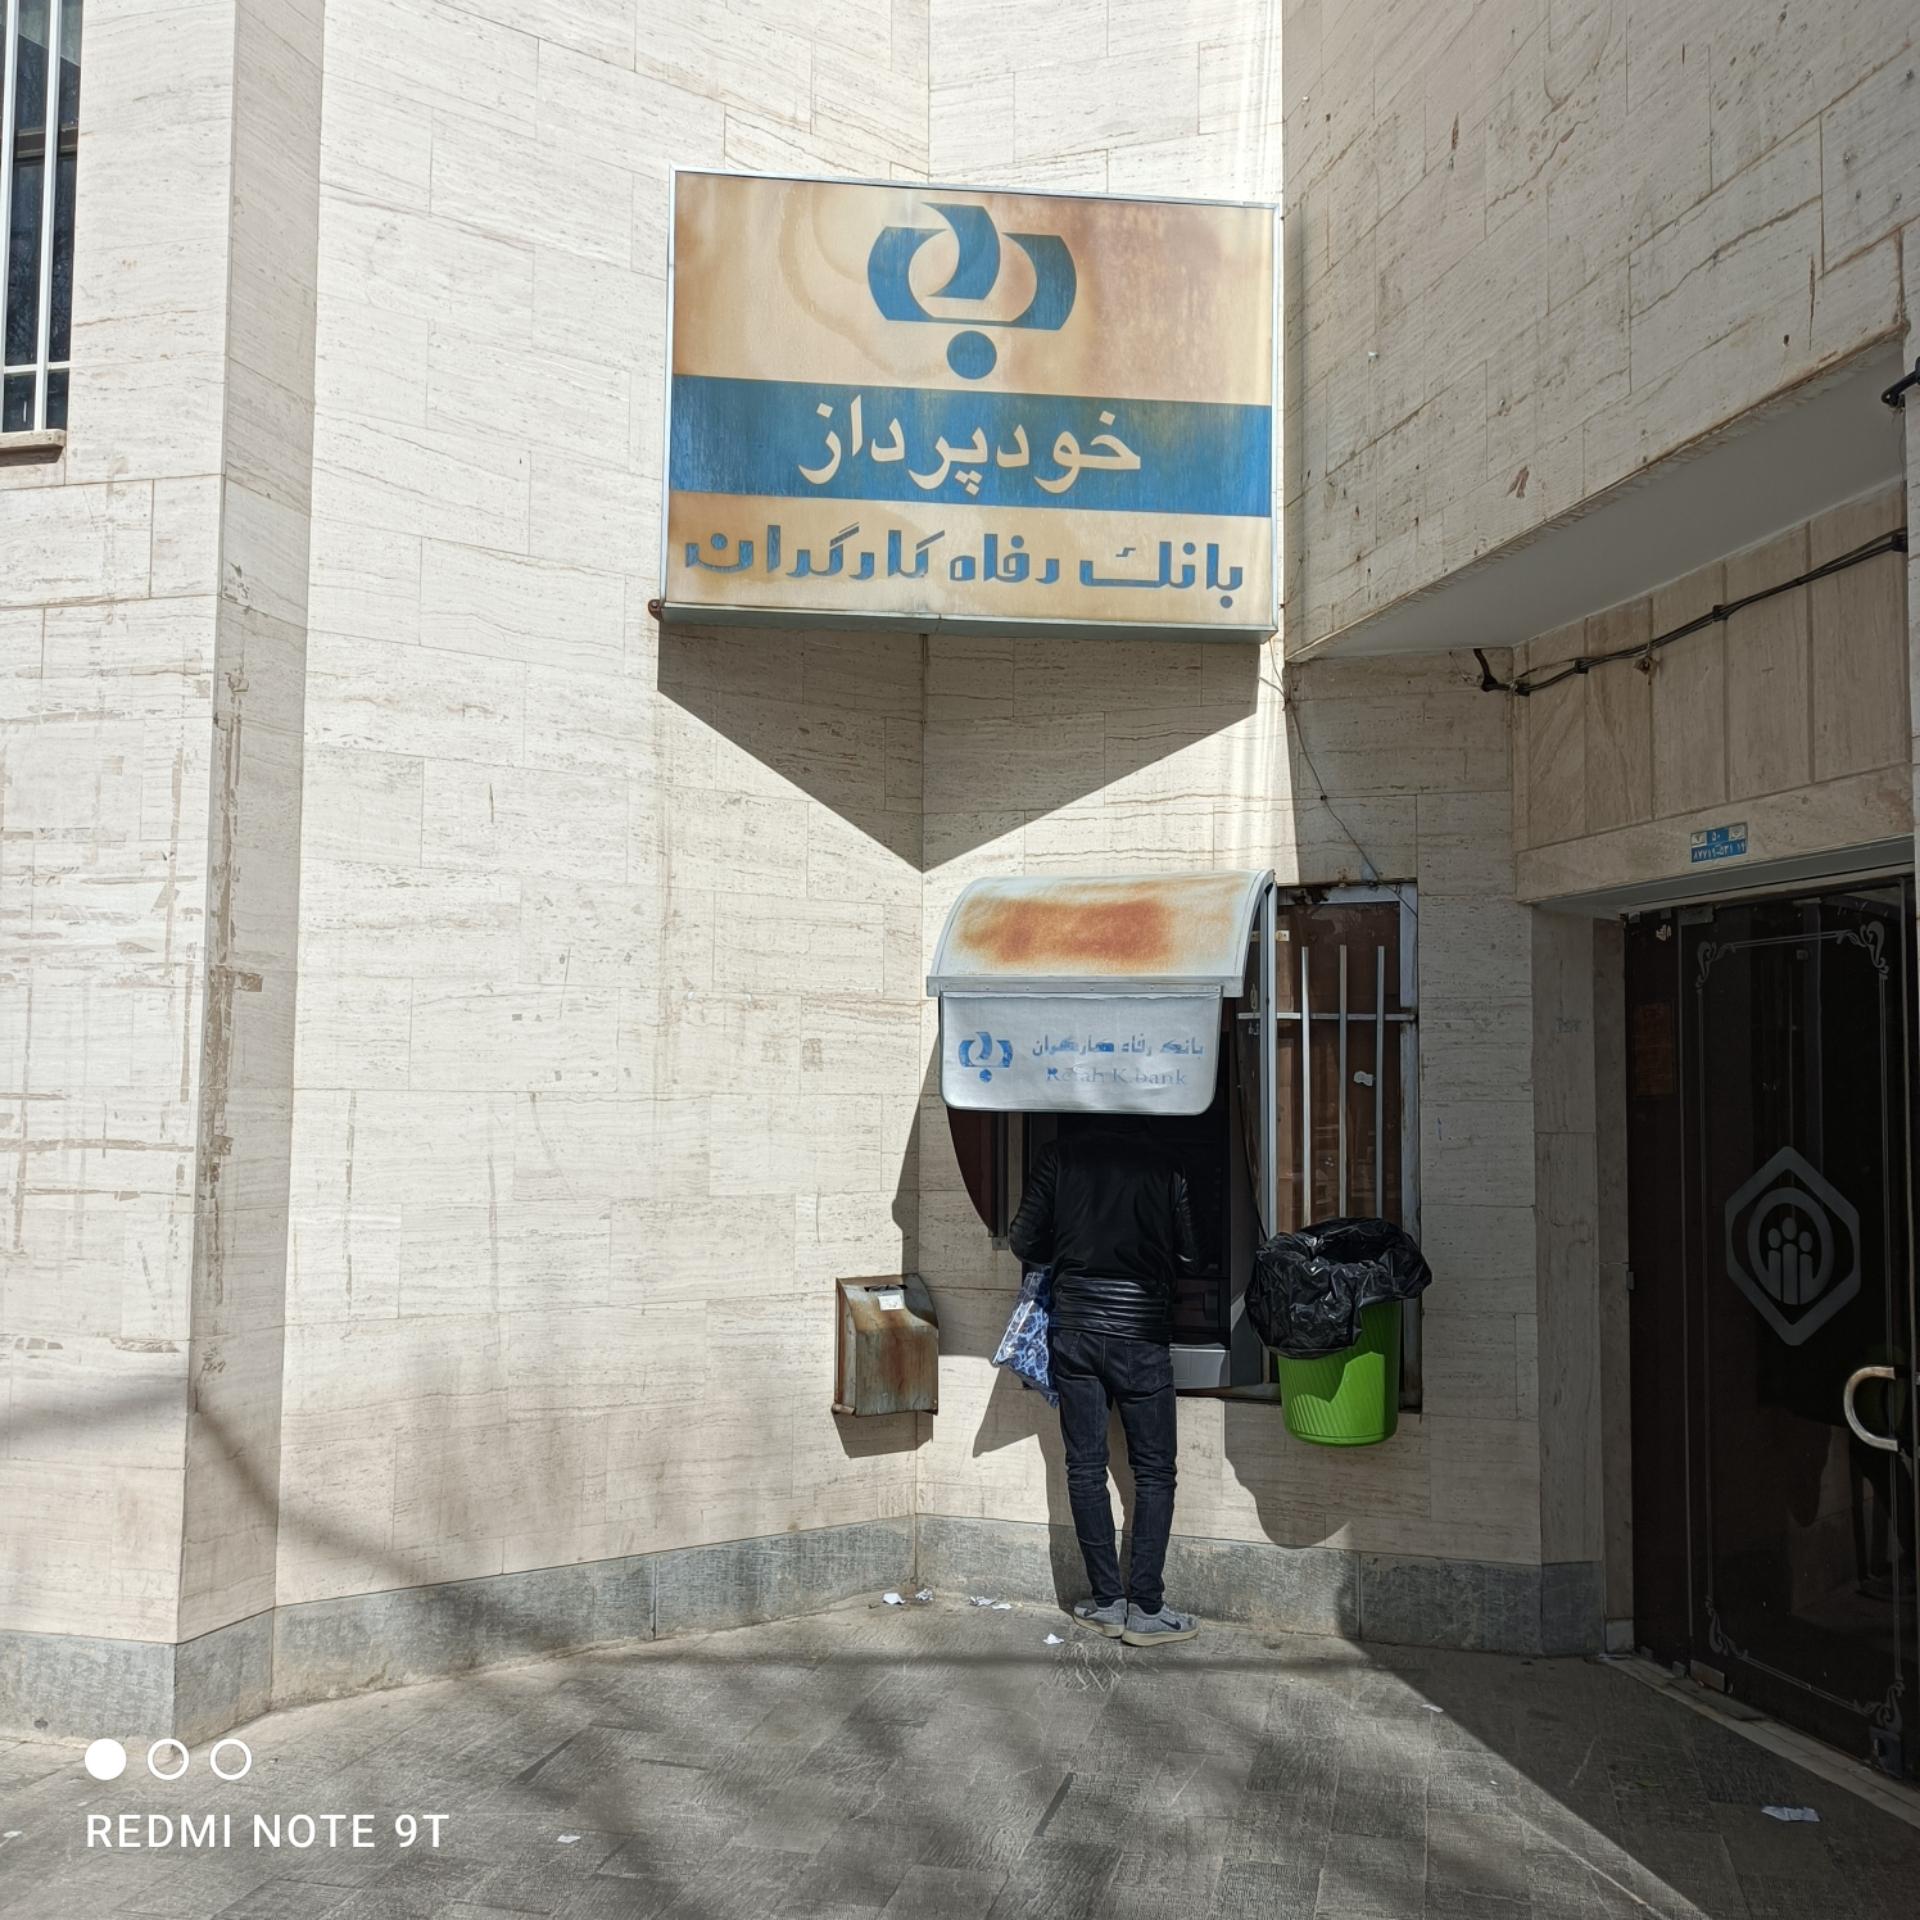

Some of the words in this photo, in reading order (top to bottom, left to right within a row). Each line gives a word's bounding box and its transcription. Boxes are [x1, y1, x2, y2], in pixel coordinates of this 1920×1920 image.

[684, 520, 946, 581] کارگران
[948, 533, 1061, 585] رفاه
[1046, 1067, 1105, 1083] Reah
